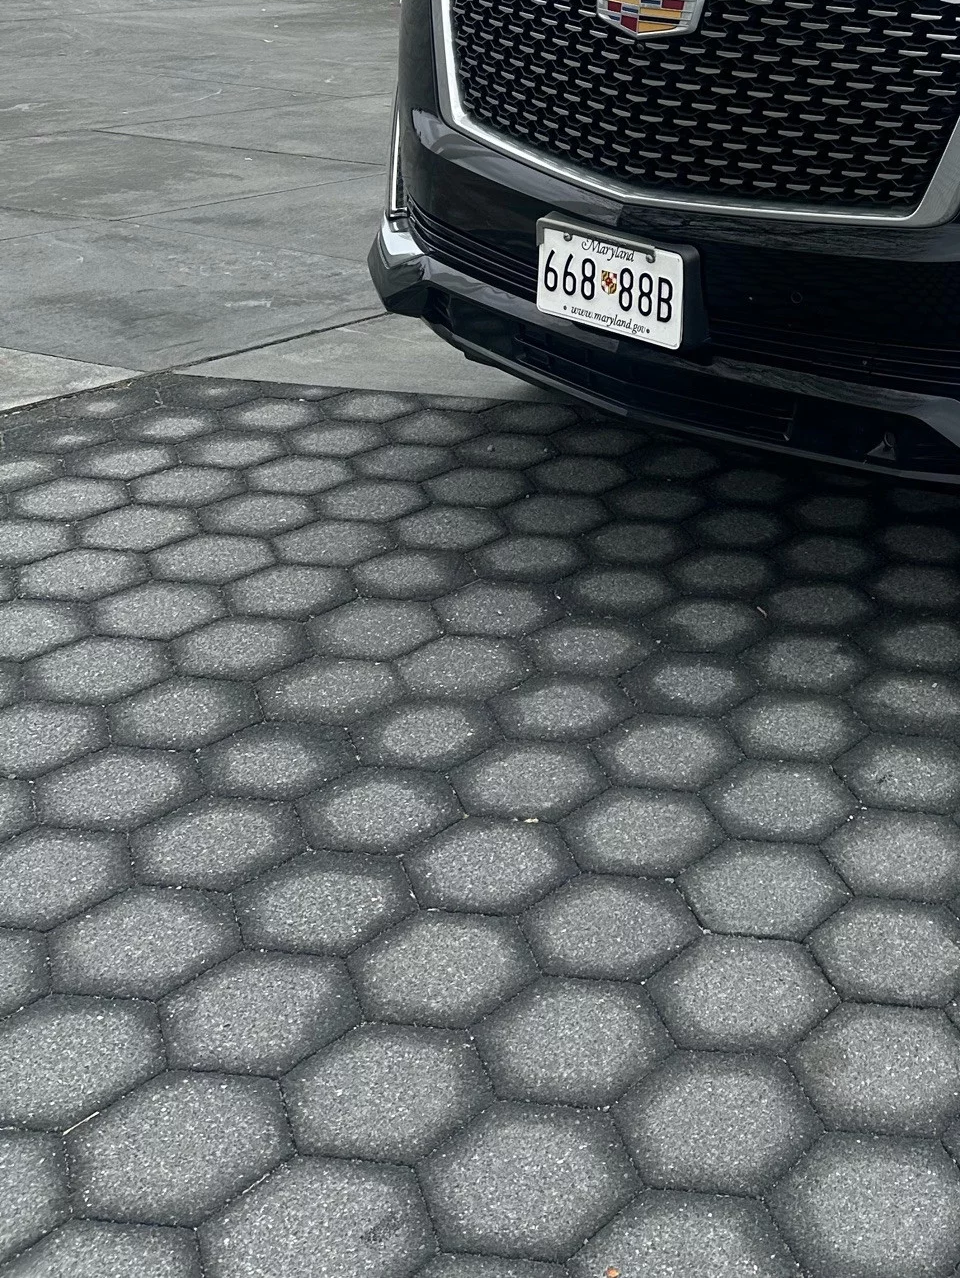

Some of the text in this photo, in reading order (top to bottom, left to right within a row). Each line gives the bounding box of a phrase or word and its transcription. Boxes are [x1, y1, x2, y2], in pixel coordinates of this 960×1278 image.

[581, 239, 635, 262] Maryland
[544, 250, 673, 323] 668 88B
[571, 305, 647, 334] www.maryland.gov
